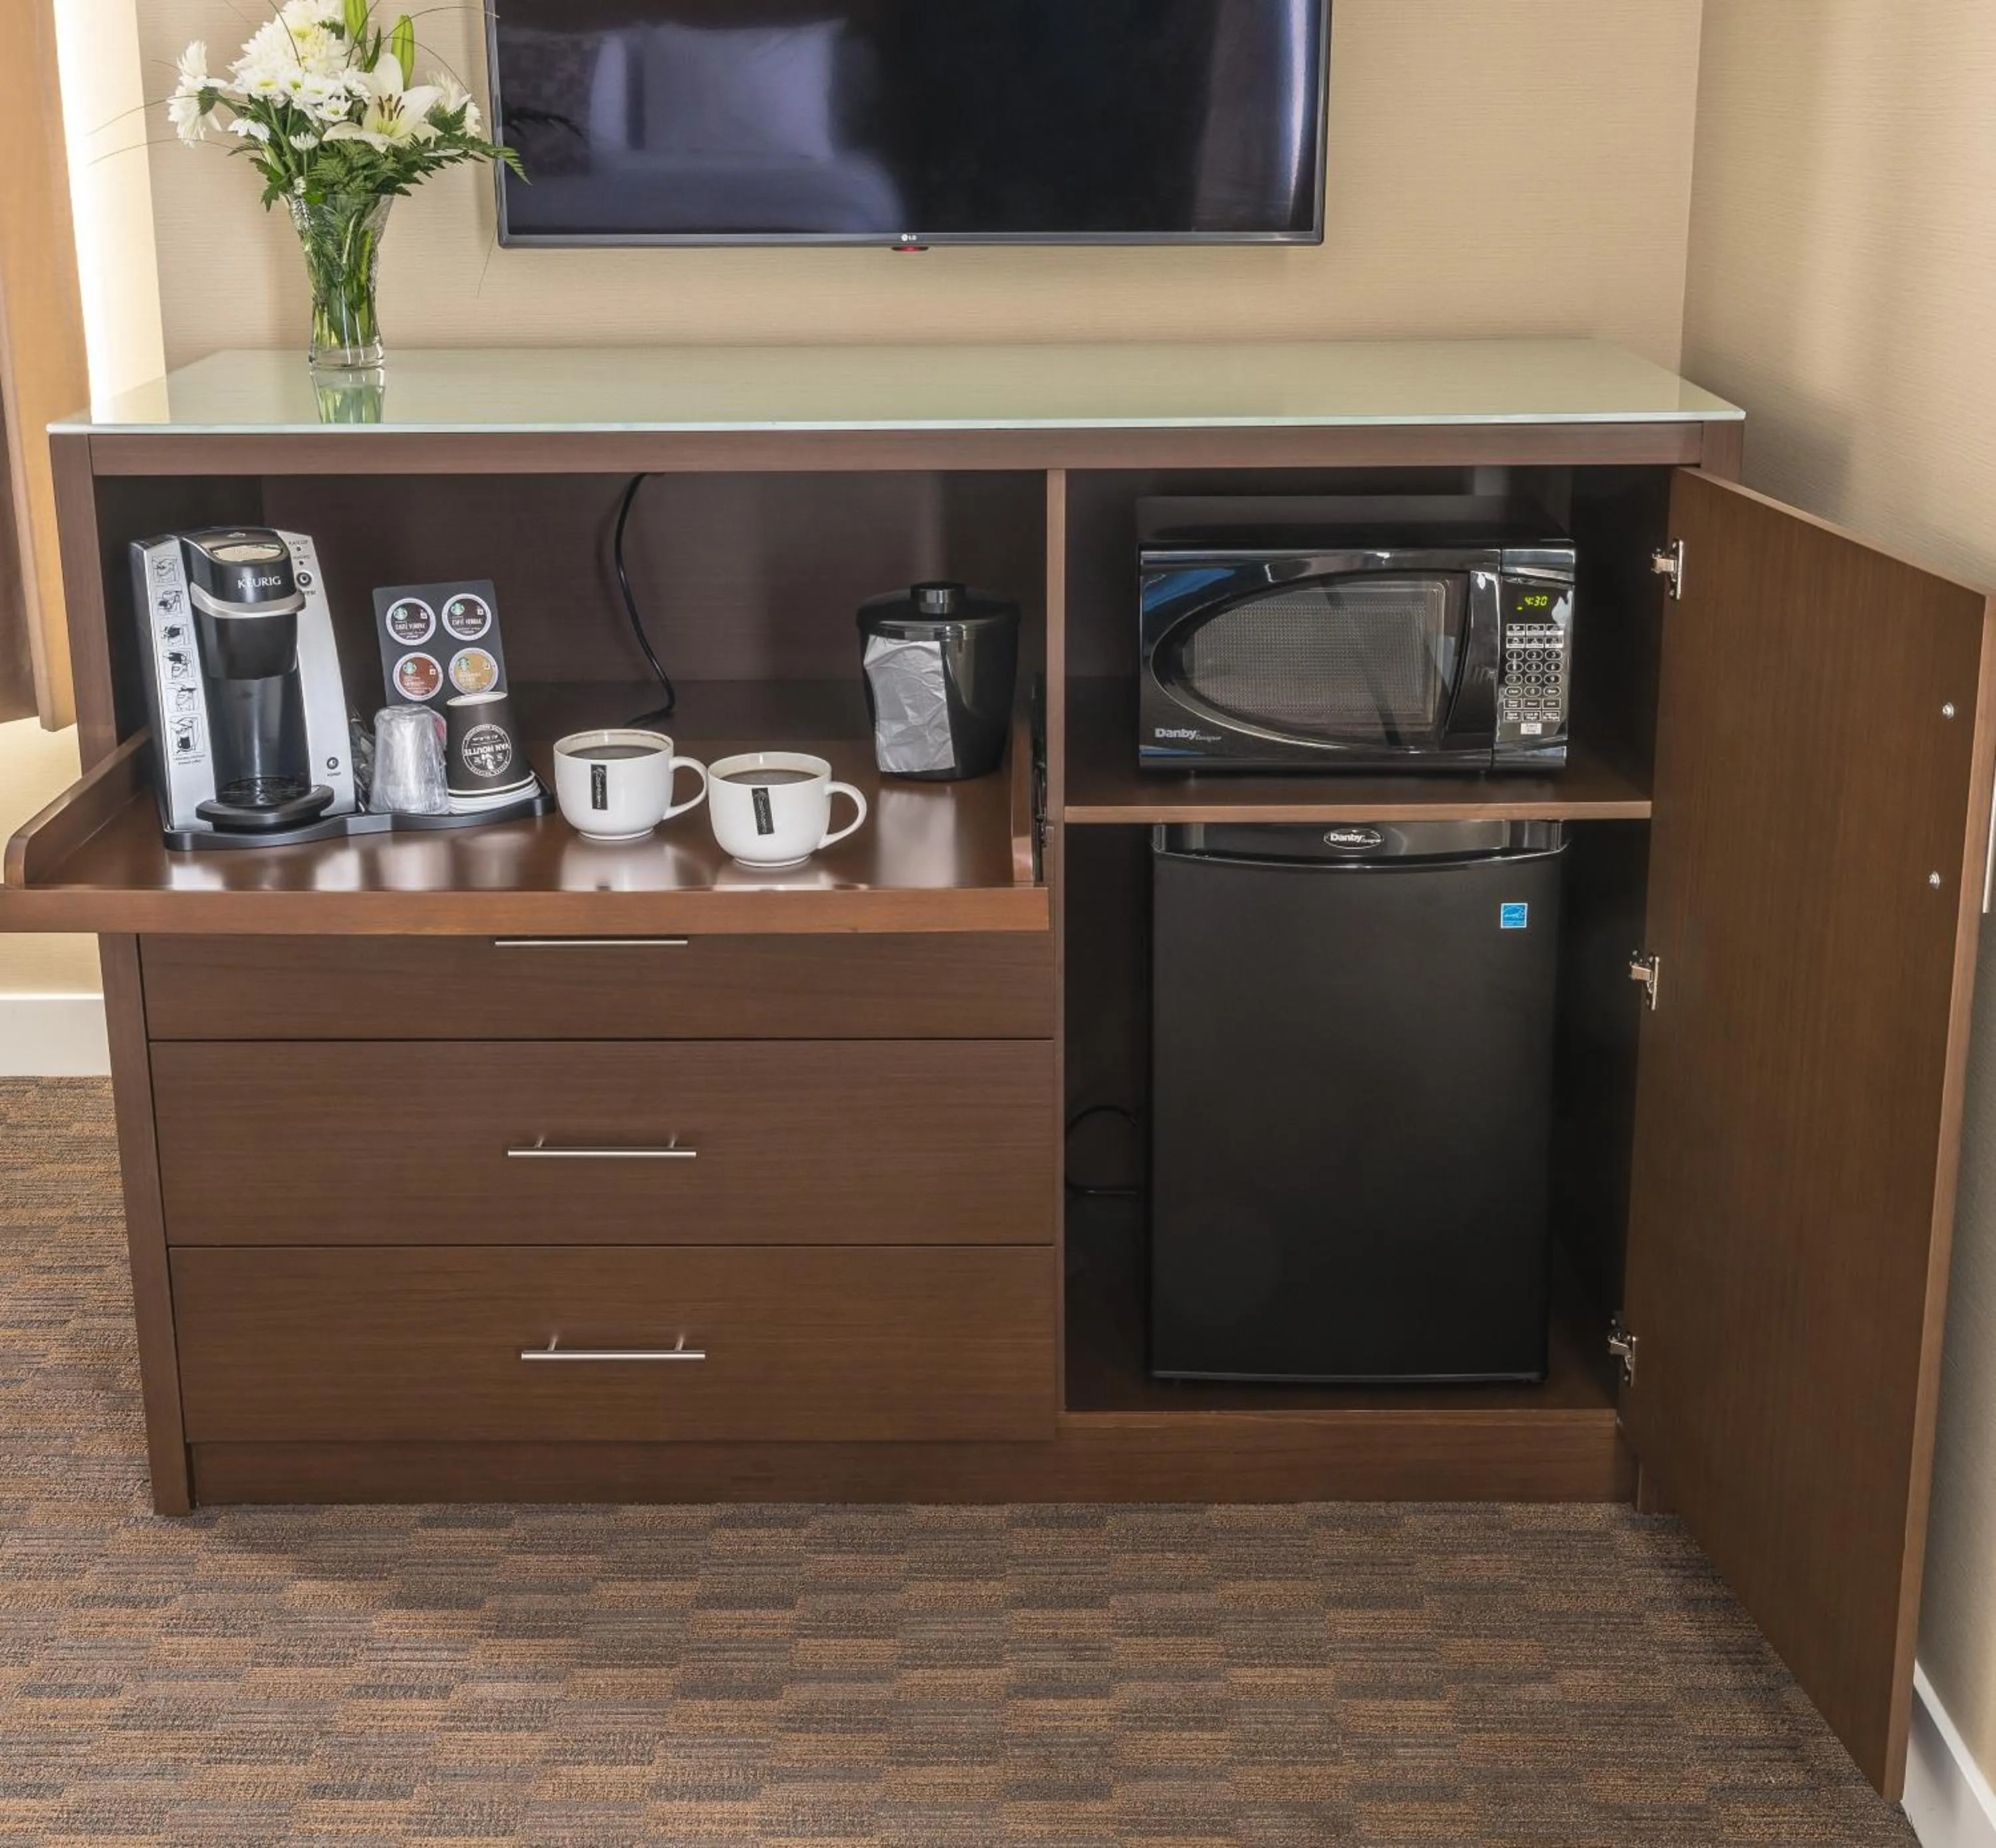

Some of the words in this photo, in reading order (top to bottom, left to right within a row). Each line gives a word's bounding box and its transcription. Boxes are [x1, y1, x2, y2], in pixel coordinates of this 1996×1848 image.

[238, 575, 281, 588] KEURIG
[1524, 595, 1548, 606] 4:30
[1155, 728, 1197, 740] Danby
[494, 743, 509, 752] VAN
[1331, 832, 1365, 844] Danby
